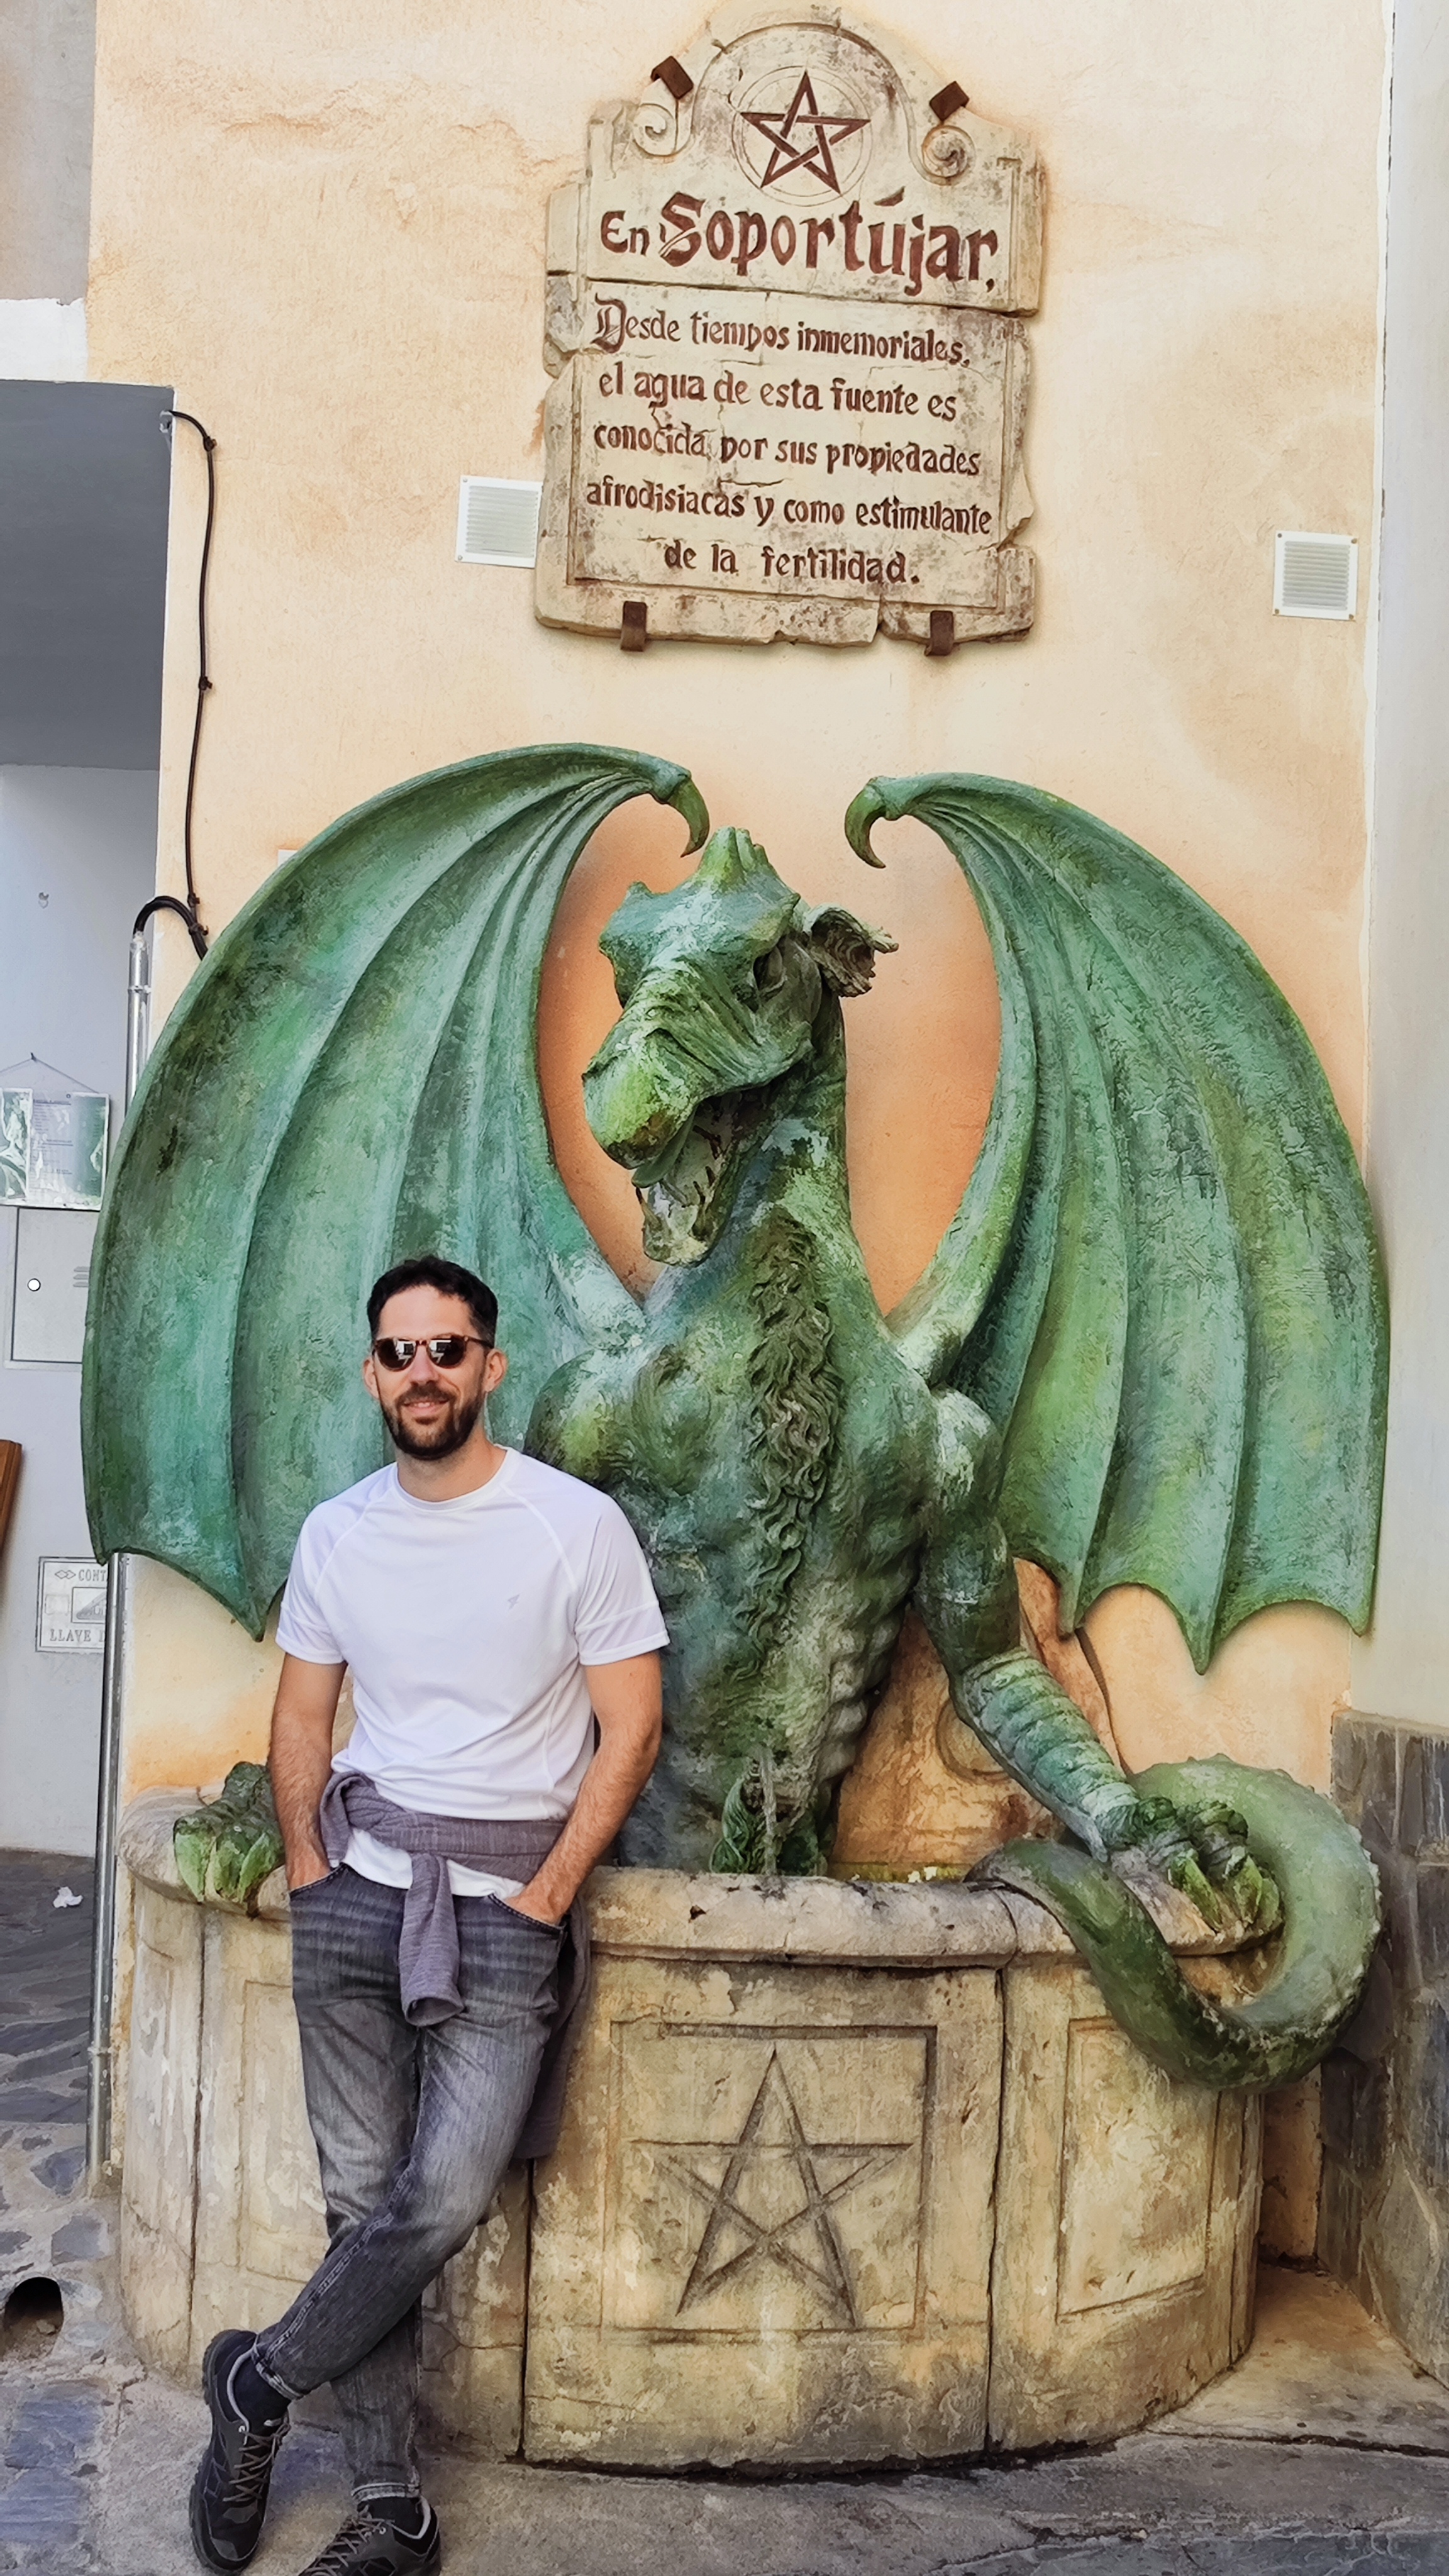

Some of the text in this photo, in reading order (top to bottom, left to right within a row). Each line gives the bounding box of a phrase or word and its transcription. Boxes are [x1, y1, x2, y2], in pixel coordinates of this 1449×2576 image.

[601, 187, 999, 296] En Soportújar,
[590, 292, 970, 368] Desde tiempos inmemoriales,
[599, 361, 957, 421] el agua de esta fuente es
[594, 421, 981, 476] conocida por sus propiedades
[586, 475, 992, 535] afrodisiacas y como estimulante
[664, 539, 920, 585] de la fertilidad.
[50, 1628, 91, 1643] LLAVE
